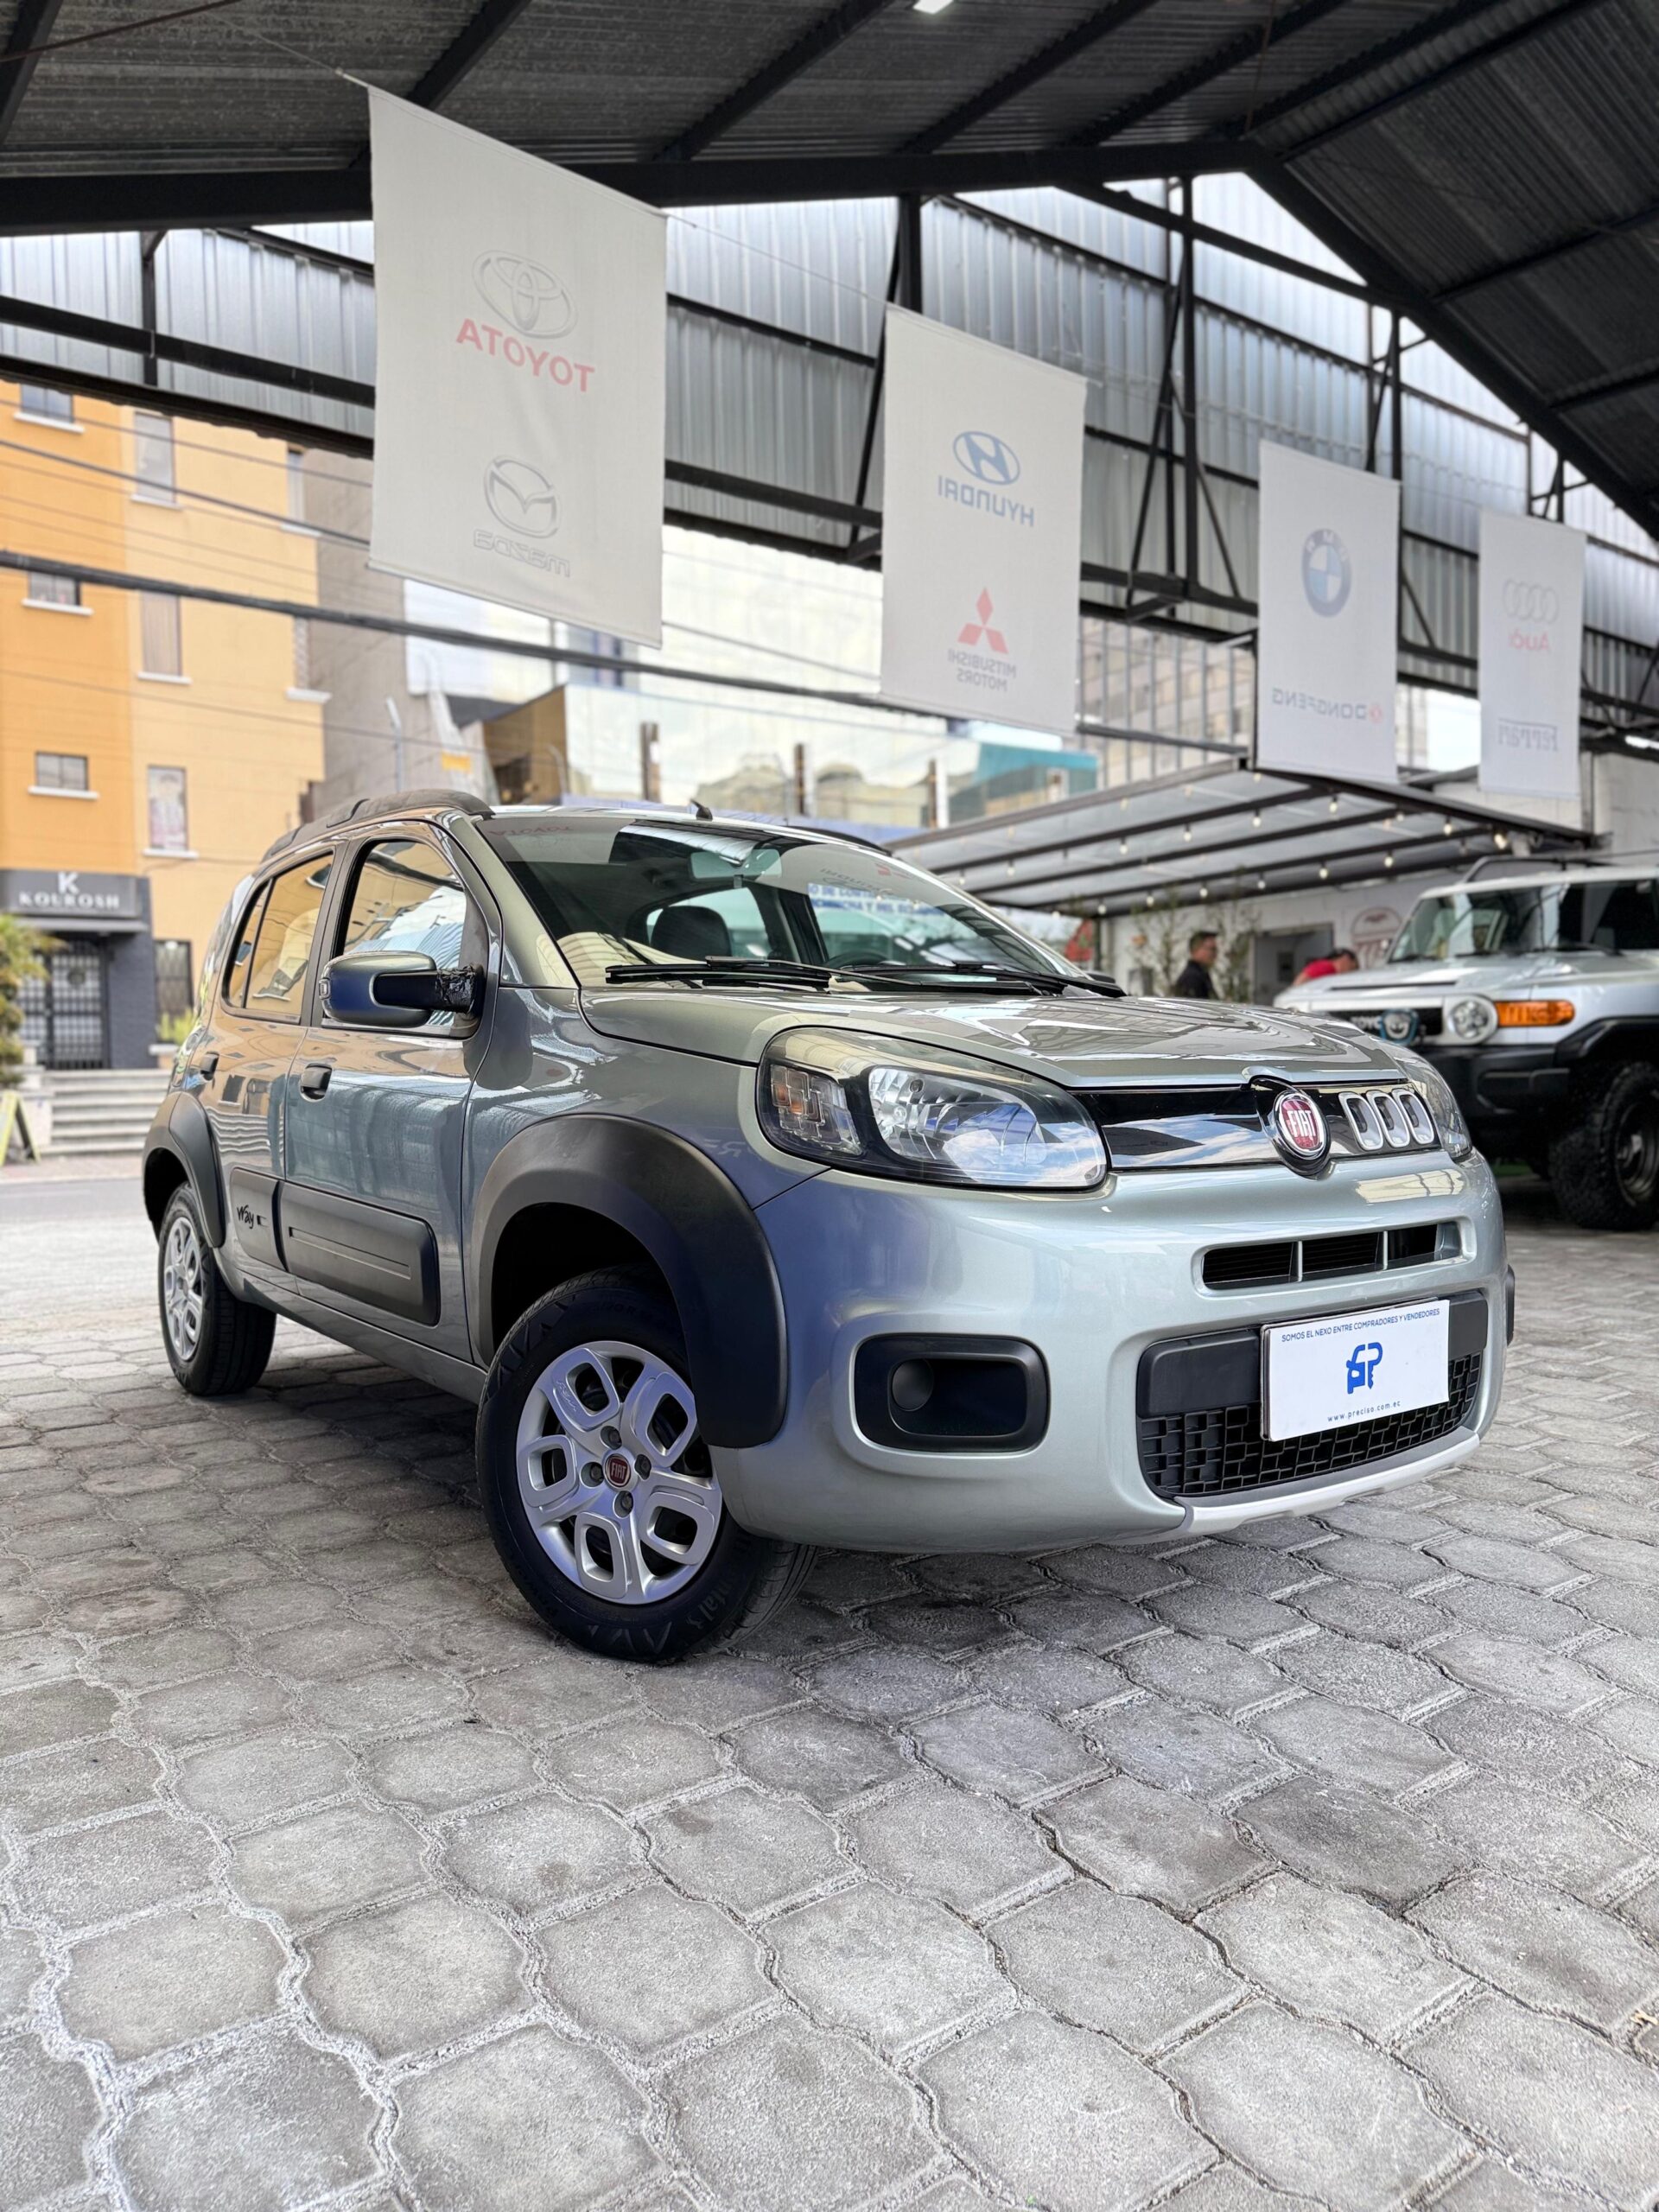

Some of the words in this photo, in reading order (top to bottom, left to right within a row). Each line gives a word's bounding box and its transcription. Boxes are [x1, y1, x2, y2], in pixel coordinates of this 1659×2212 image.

[57, 872, 79, 893] K
[1287, 1109, 1316, 1138] FIAT
[236, 1205, 255, 1230] Way
[1281, 1331, 1305, 1343] SOMOS
[1306, 1330, 1314, 1338] EL
[1314, 1326, 1332, 1337] NEXO
[1333, 1323, 1353, 1334] ENTRE
[1353, 1315, 1399, 1331] COMPRADORES
[1404, 1307, 1440, 1321] VENDEDORES
[1327, 1400, 1402, 1422] www.preciso.com.ec
[611, 1462, 626, 1480] FIAT
